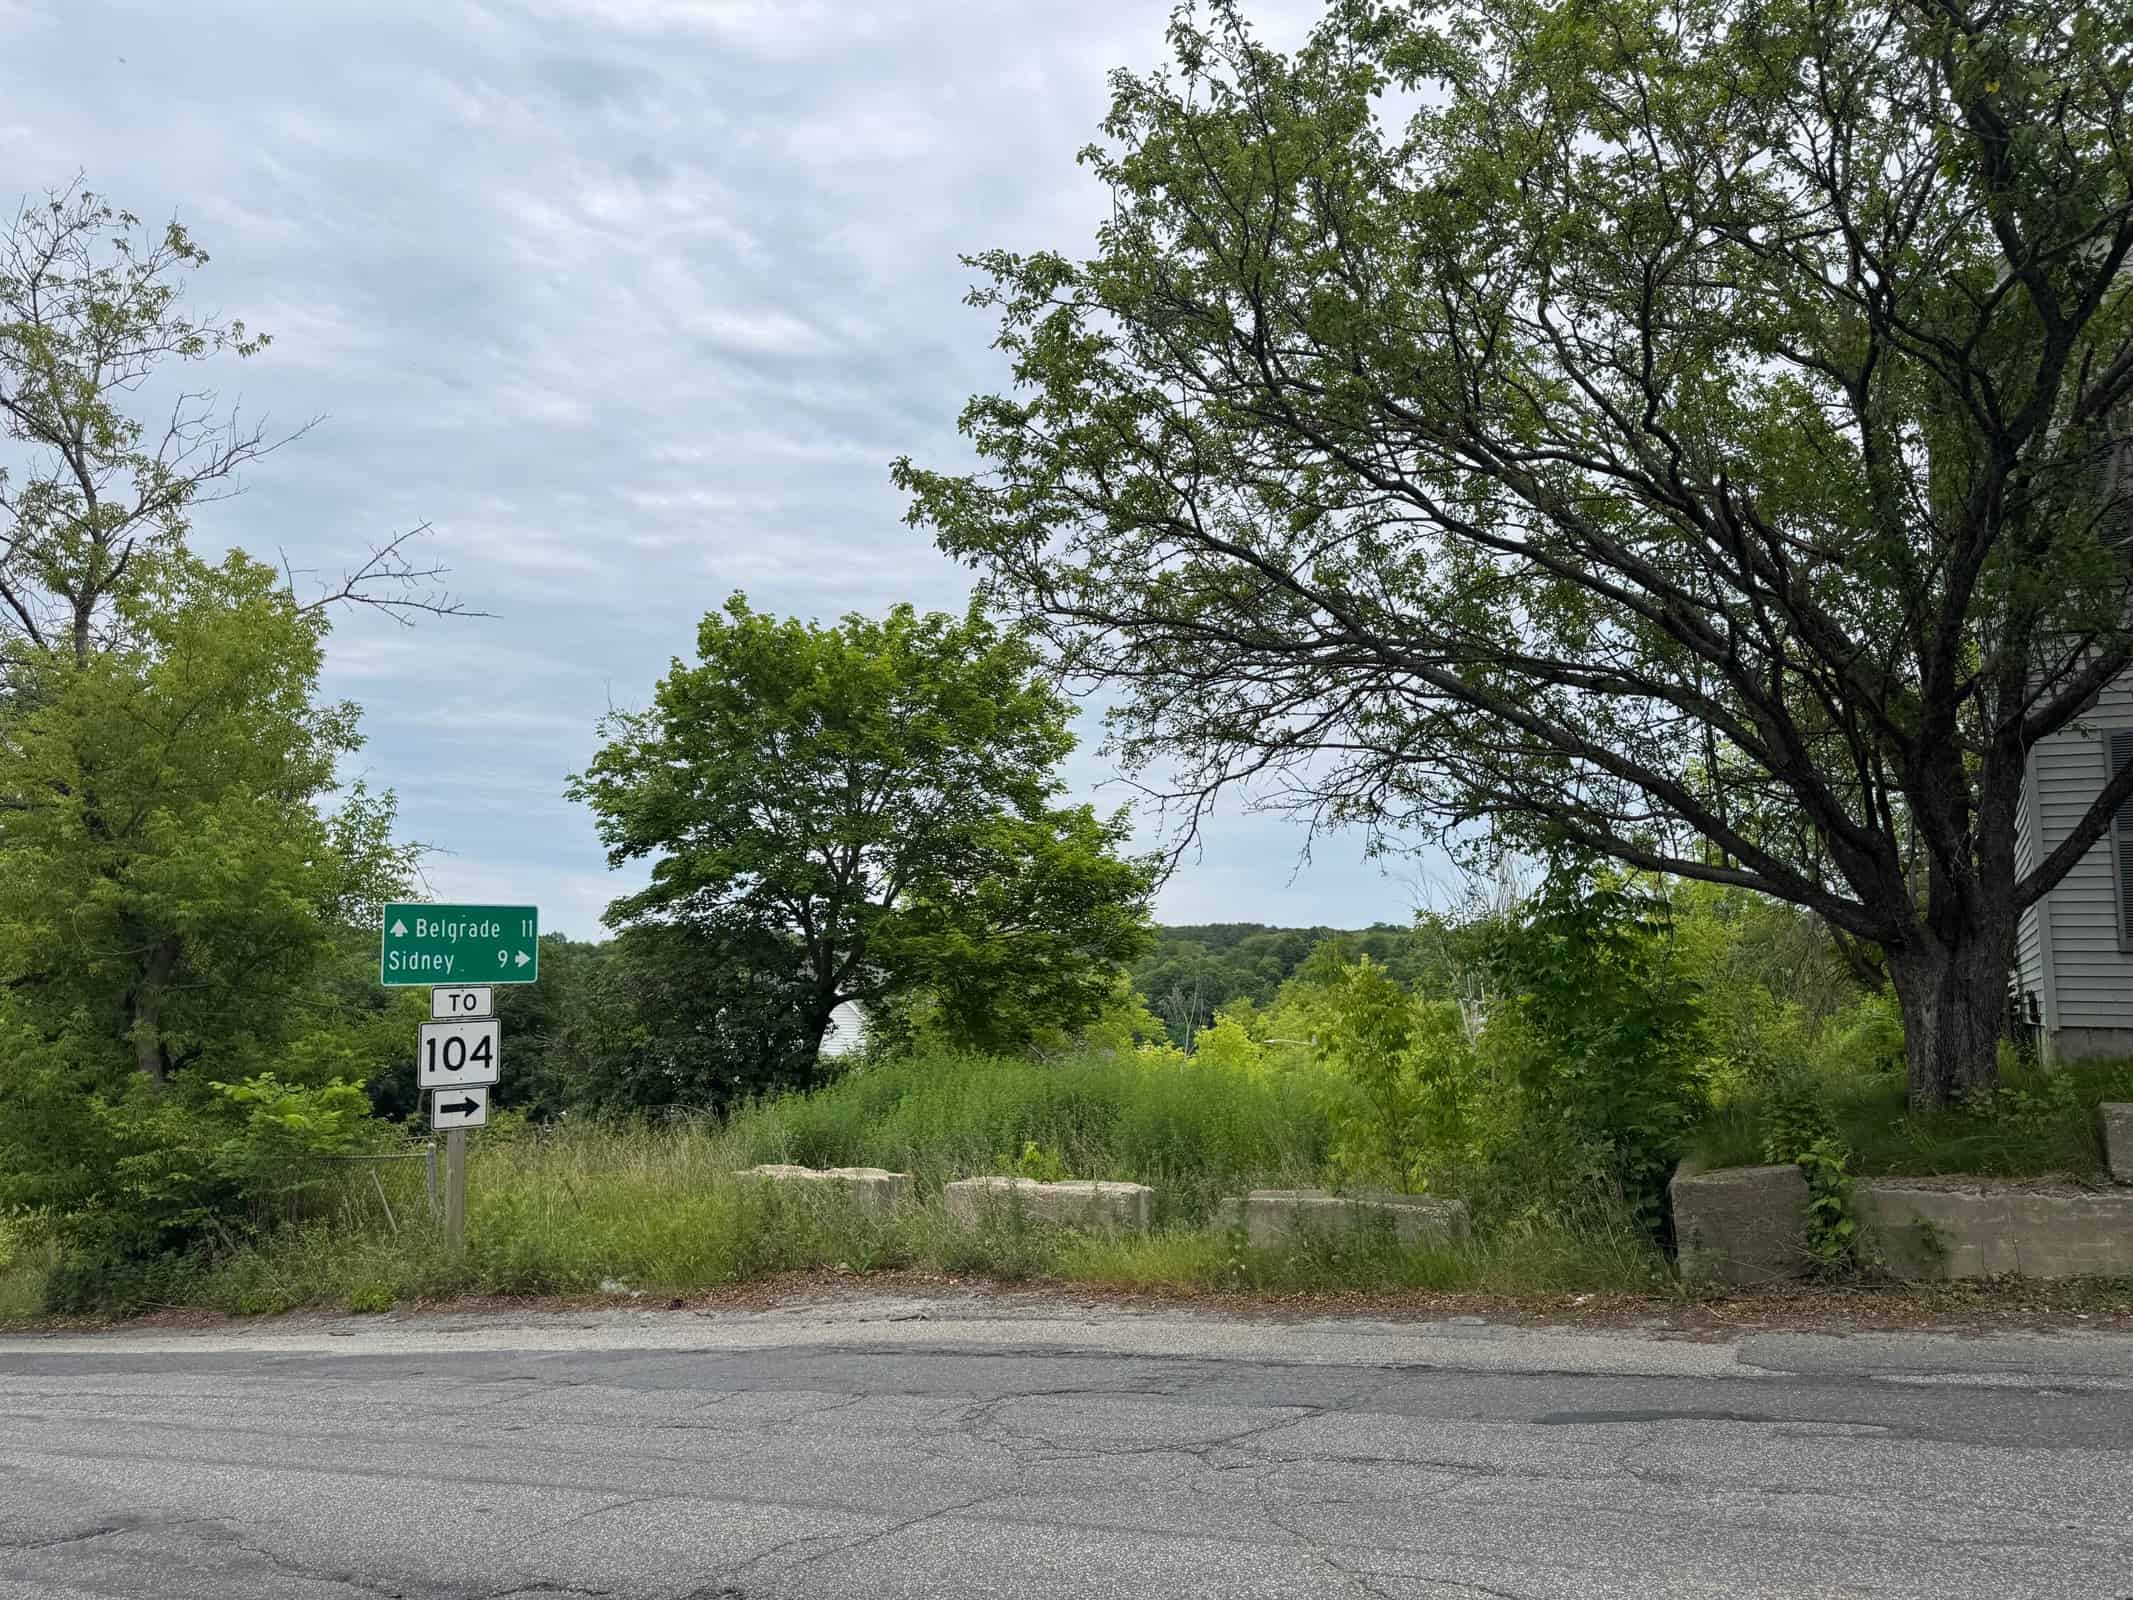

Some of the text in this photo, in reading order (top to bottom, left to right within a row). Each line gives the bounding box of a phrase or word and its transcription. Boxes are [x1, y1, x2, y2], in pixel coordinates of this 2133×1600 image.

[416, 919, 534, 943] Belgrade 11
[389, 950, 508, 974] Sidney 9
[448, 994, 477, 1011] TO
[426, 1035, 493, 1072] 104
